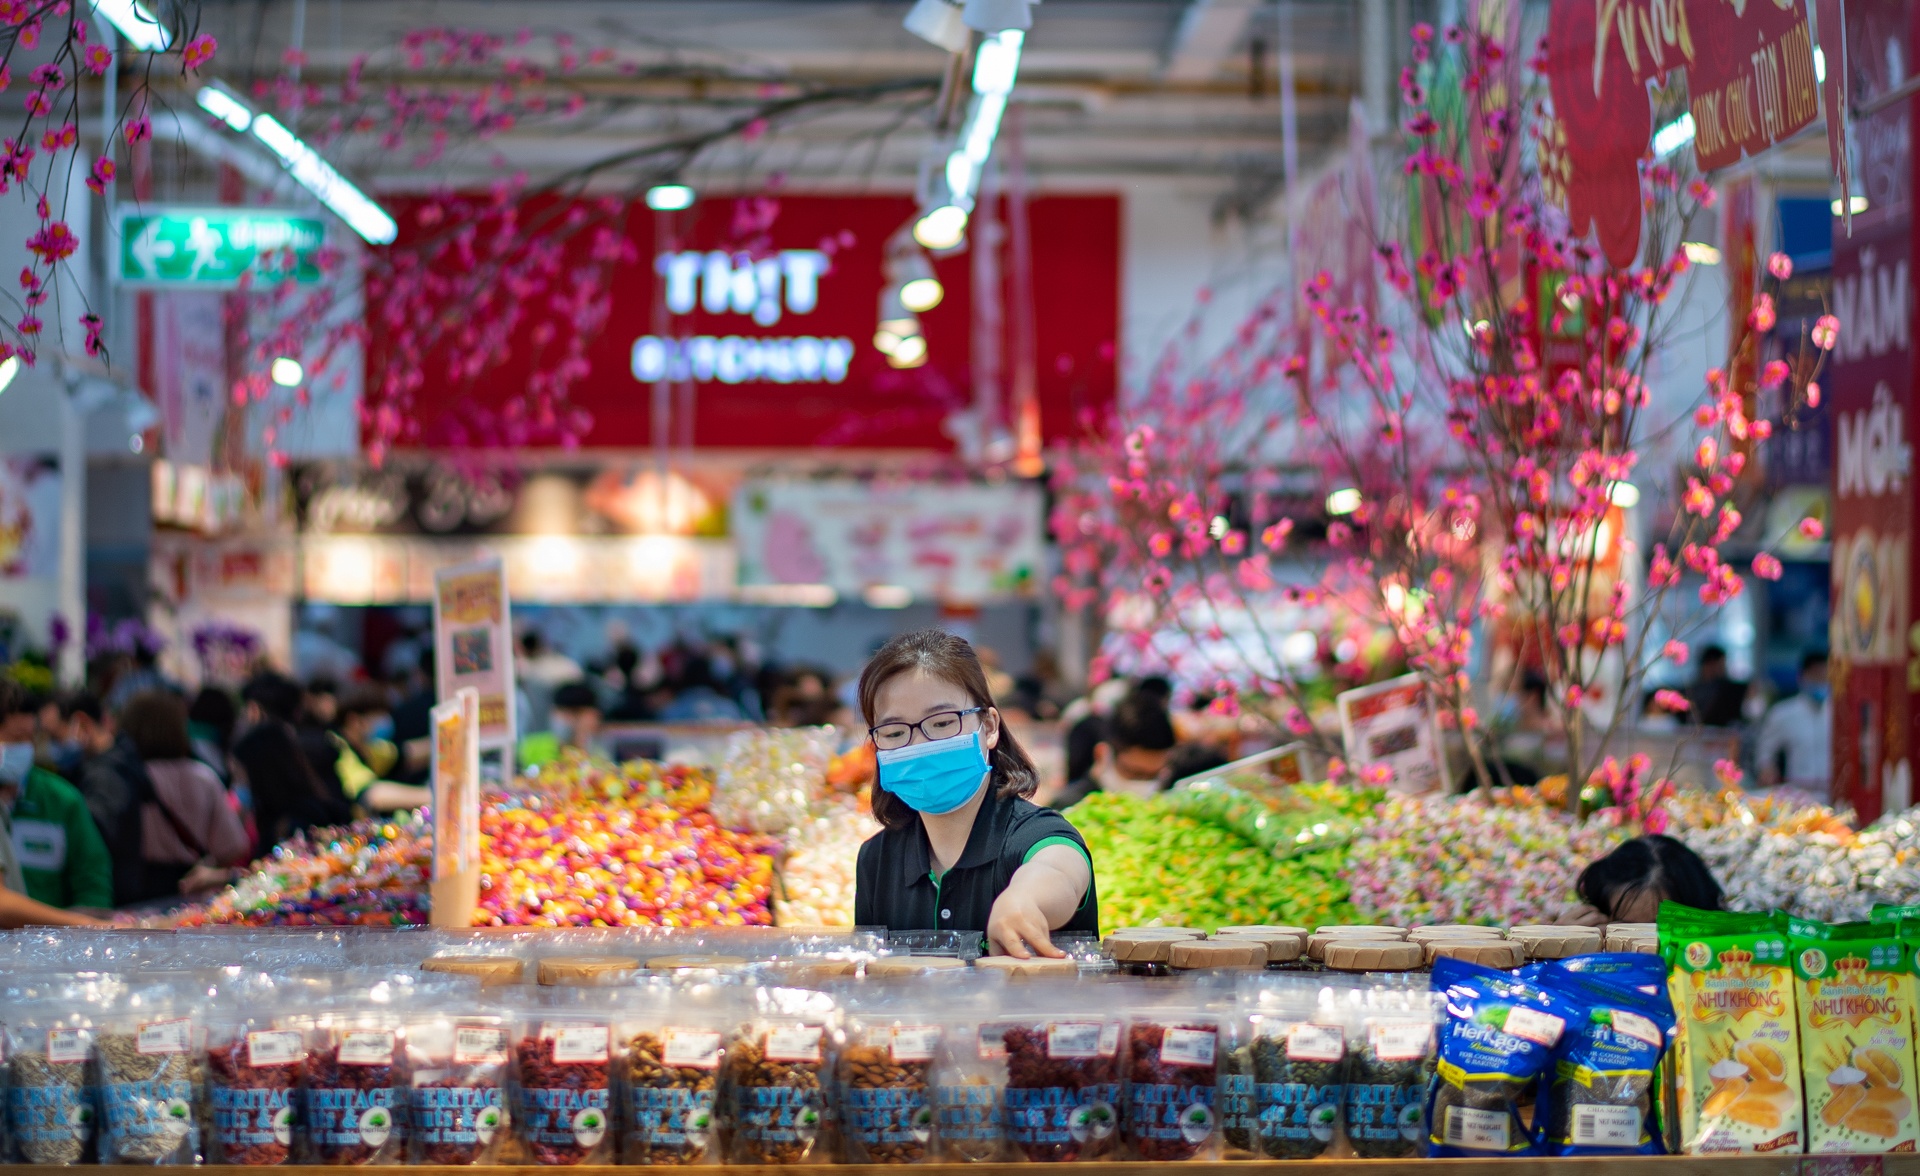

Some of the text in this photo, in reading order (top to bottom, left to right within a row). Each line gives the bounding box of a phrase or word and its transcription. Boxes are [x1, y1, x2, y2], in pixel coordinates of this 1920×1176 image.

[1746, 977, 1771, 991] Chay
[1862, 985, 1887, 998] Chay
[1729, 987, 1781, 1009] KHÔNG
[1845, 994, 1897, 1015] KHÔNG
[1581, 1023, 1650, 1052] eriage
[1474, 1052, 1510, 1067] COOKING
[1597, 1057, 1630, 1067] BAKING
[1599, 1052, 1636, 1063] COOKING
[342, 1106, 360, 1129] &
[461, 1106, 476, 1128] &
[1607, 1130, 1618, 1138] 500
